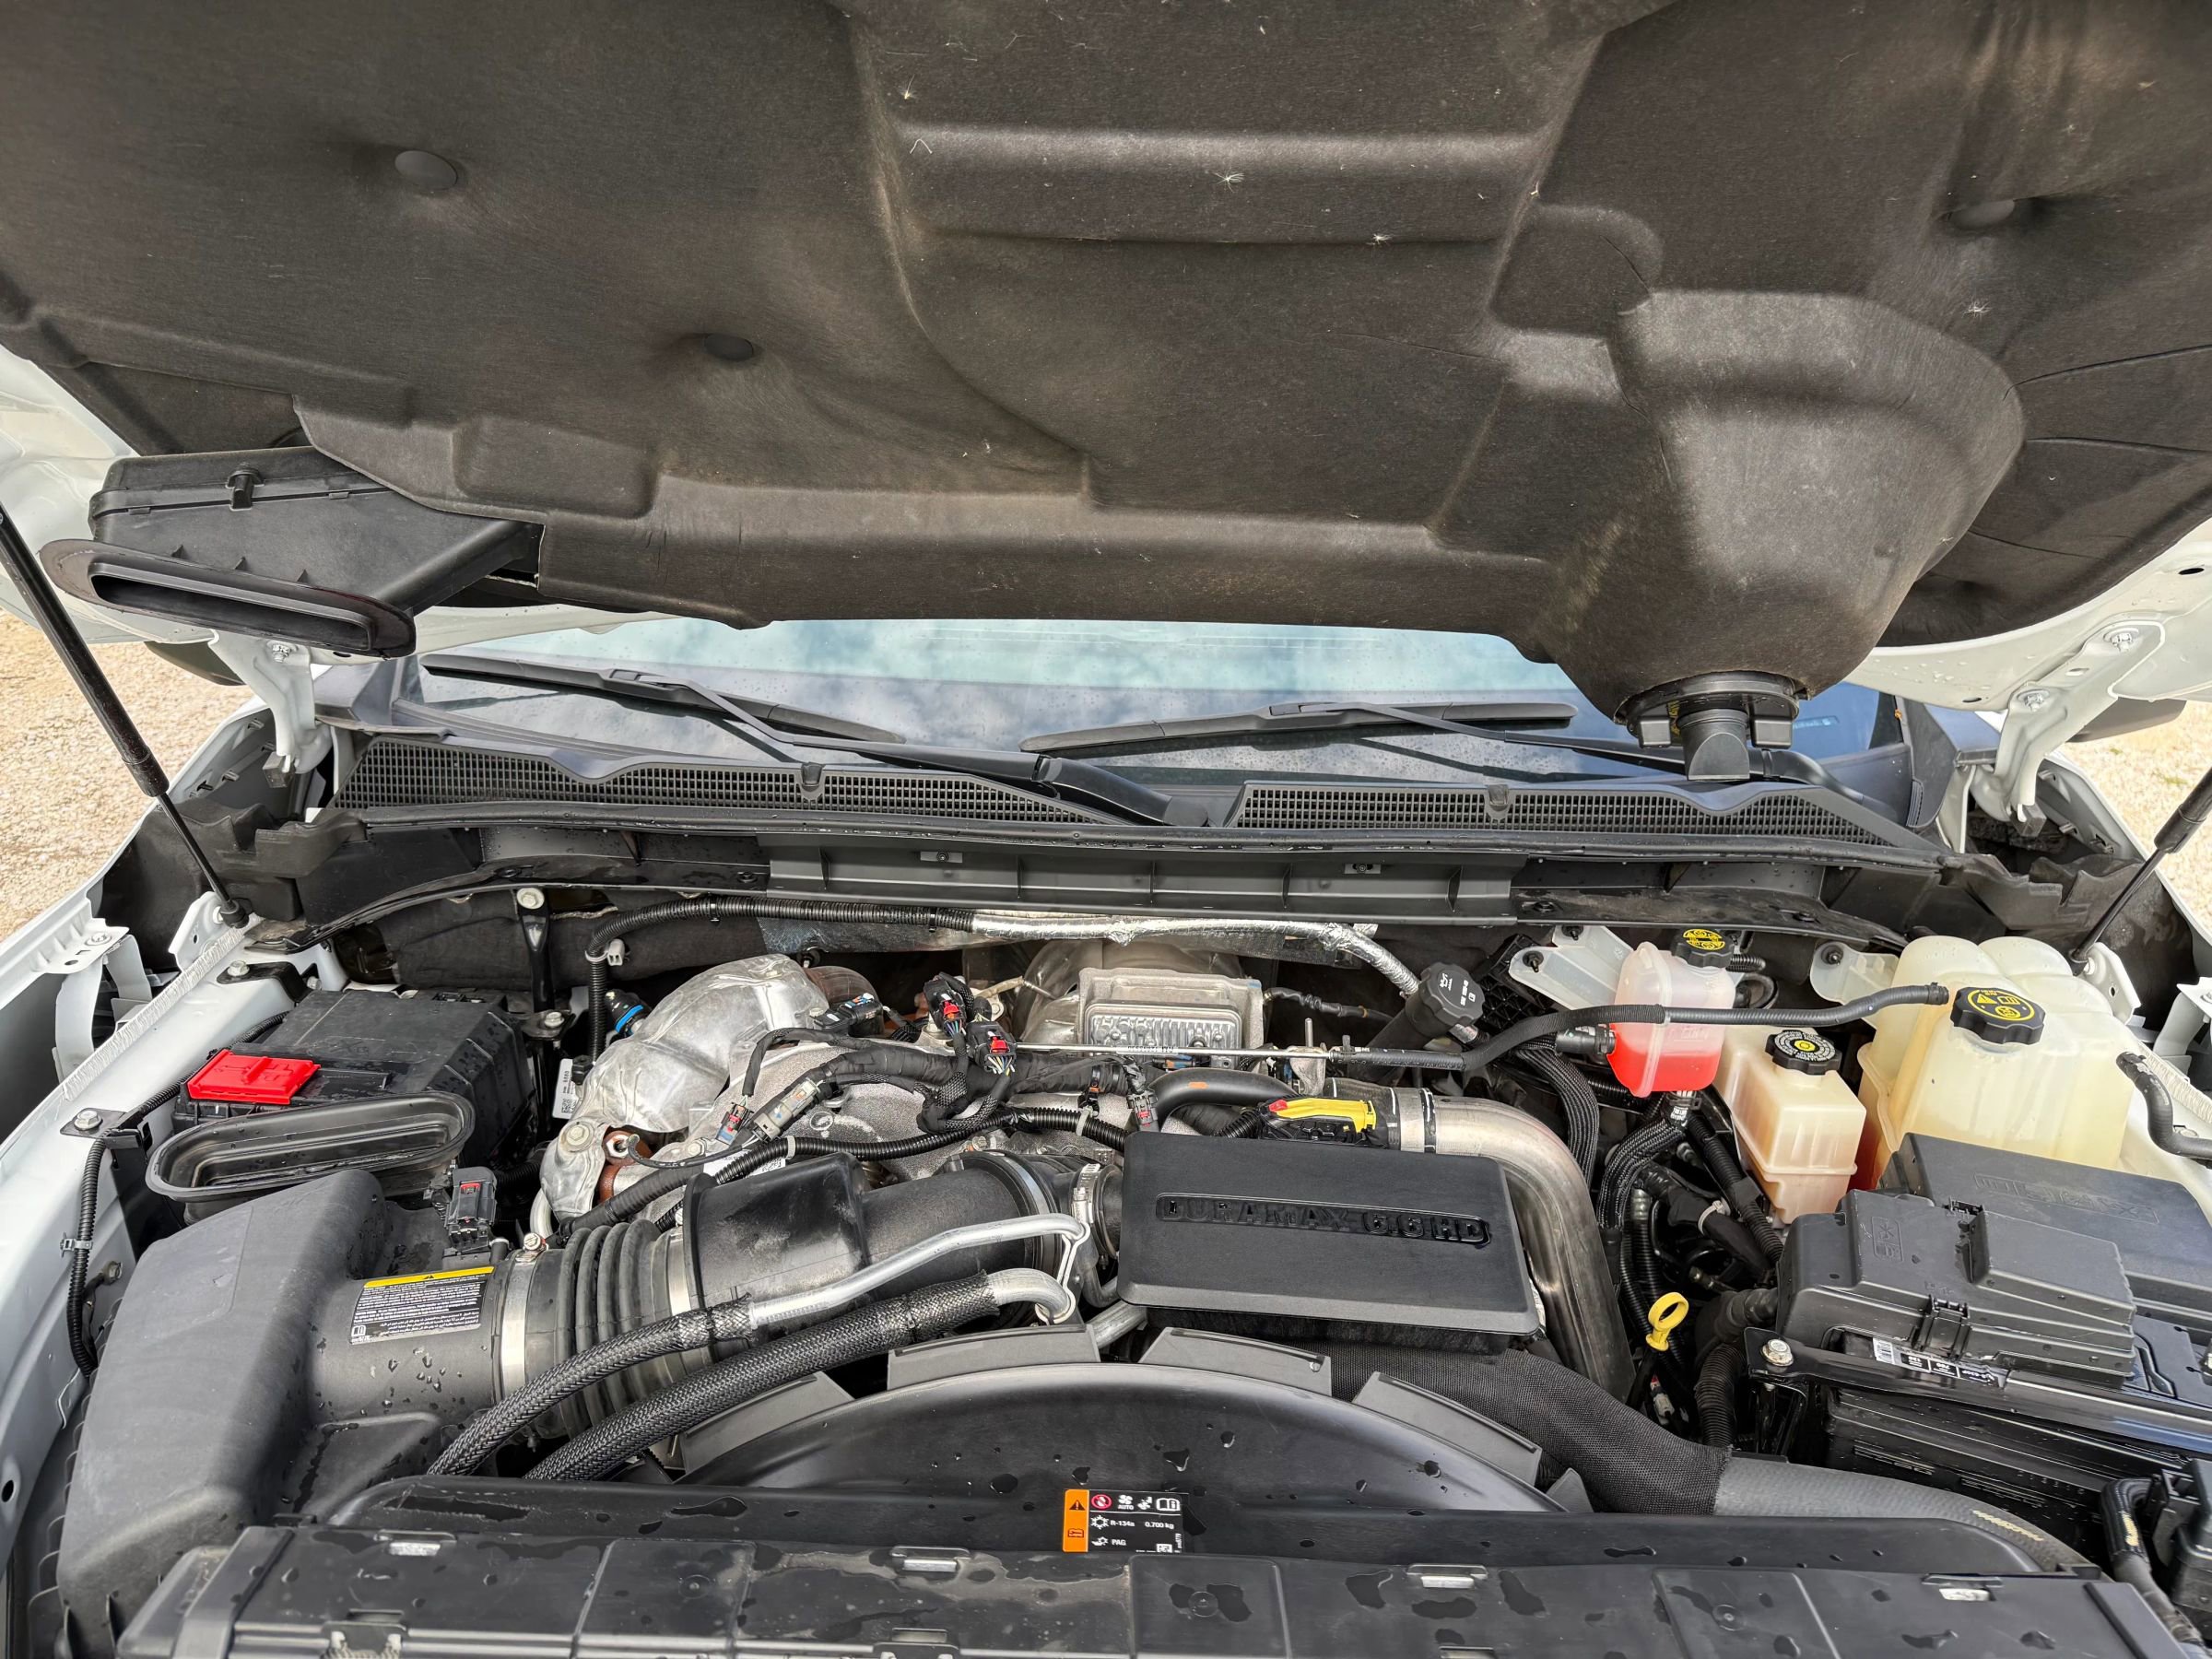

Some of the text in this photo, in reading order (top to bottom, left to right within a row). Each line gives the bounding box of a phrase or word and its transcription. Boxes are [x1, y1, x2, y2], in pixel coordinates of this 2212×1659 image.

[1161, 1198, 1487, 1243] DURAMAX 6.6 HD
[1112, 1538, 1127, 1547] PAG
